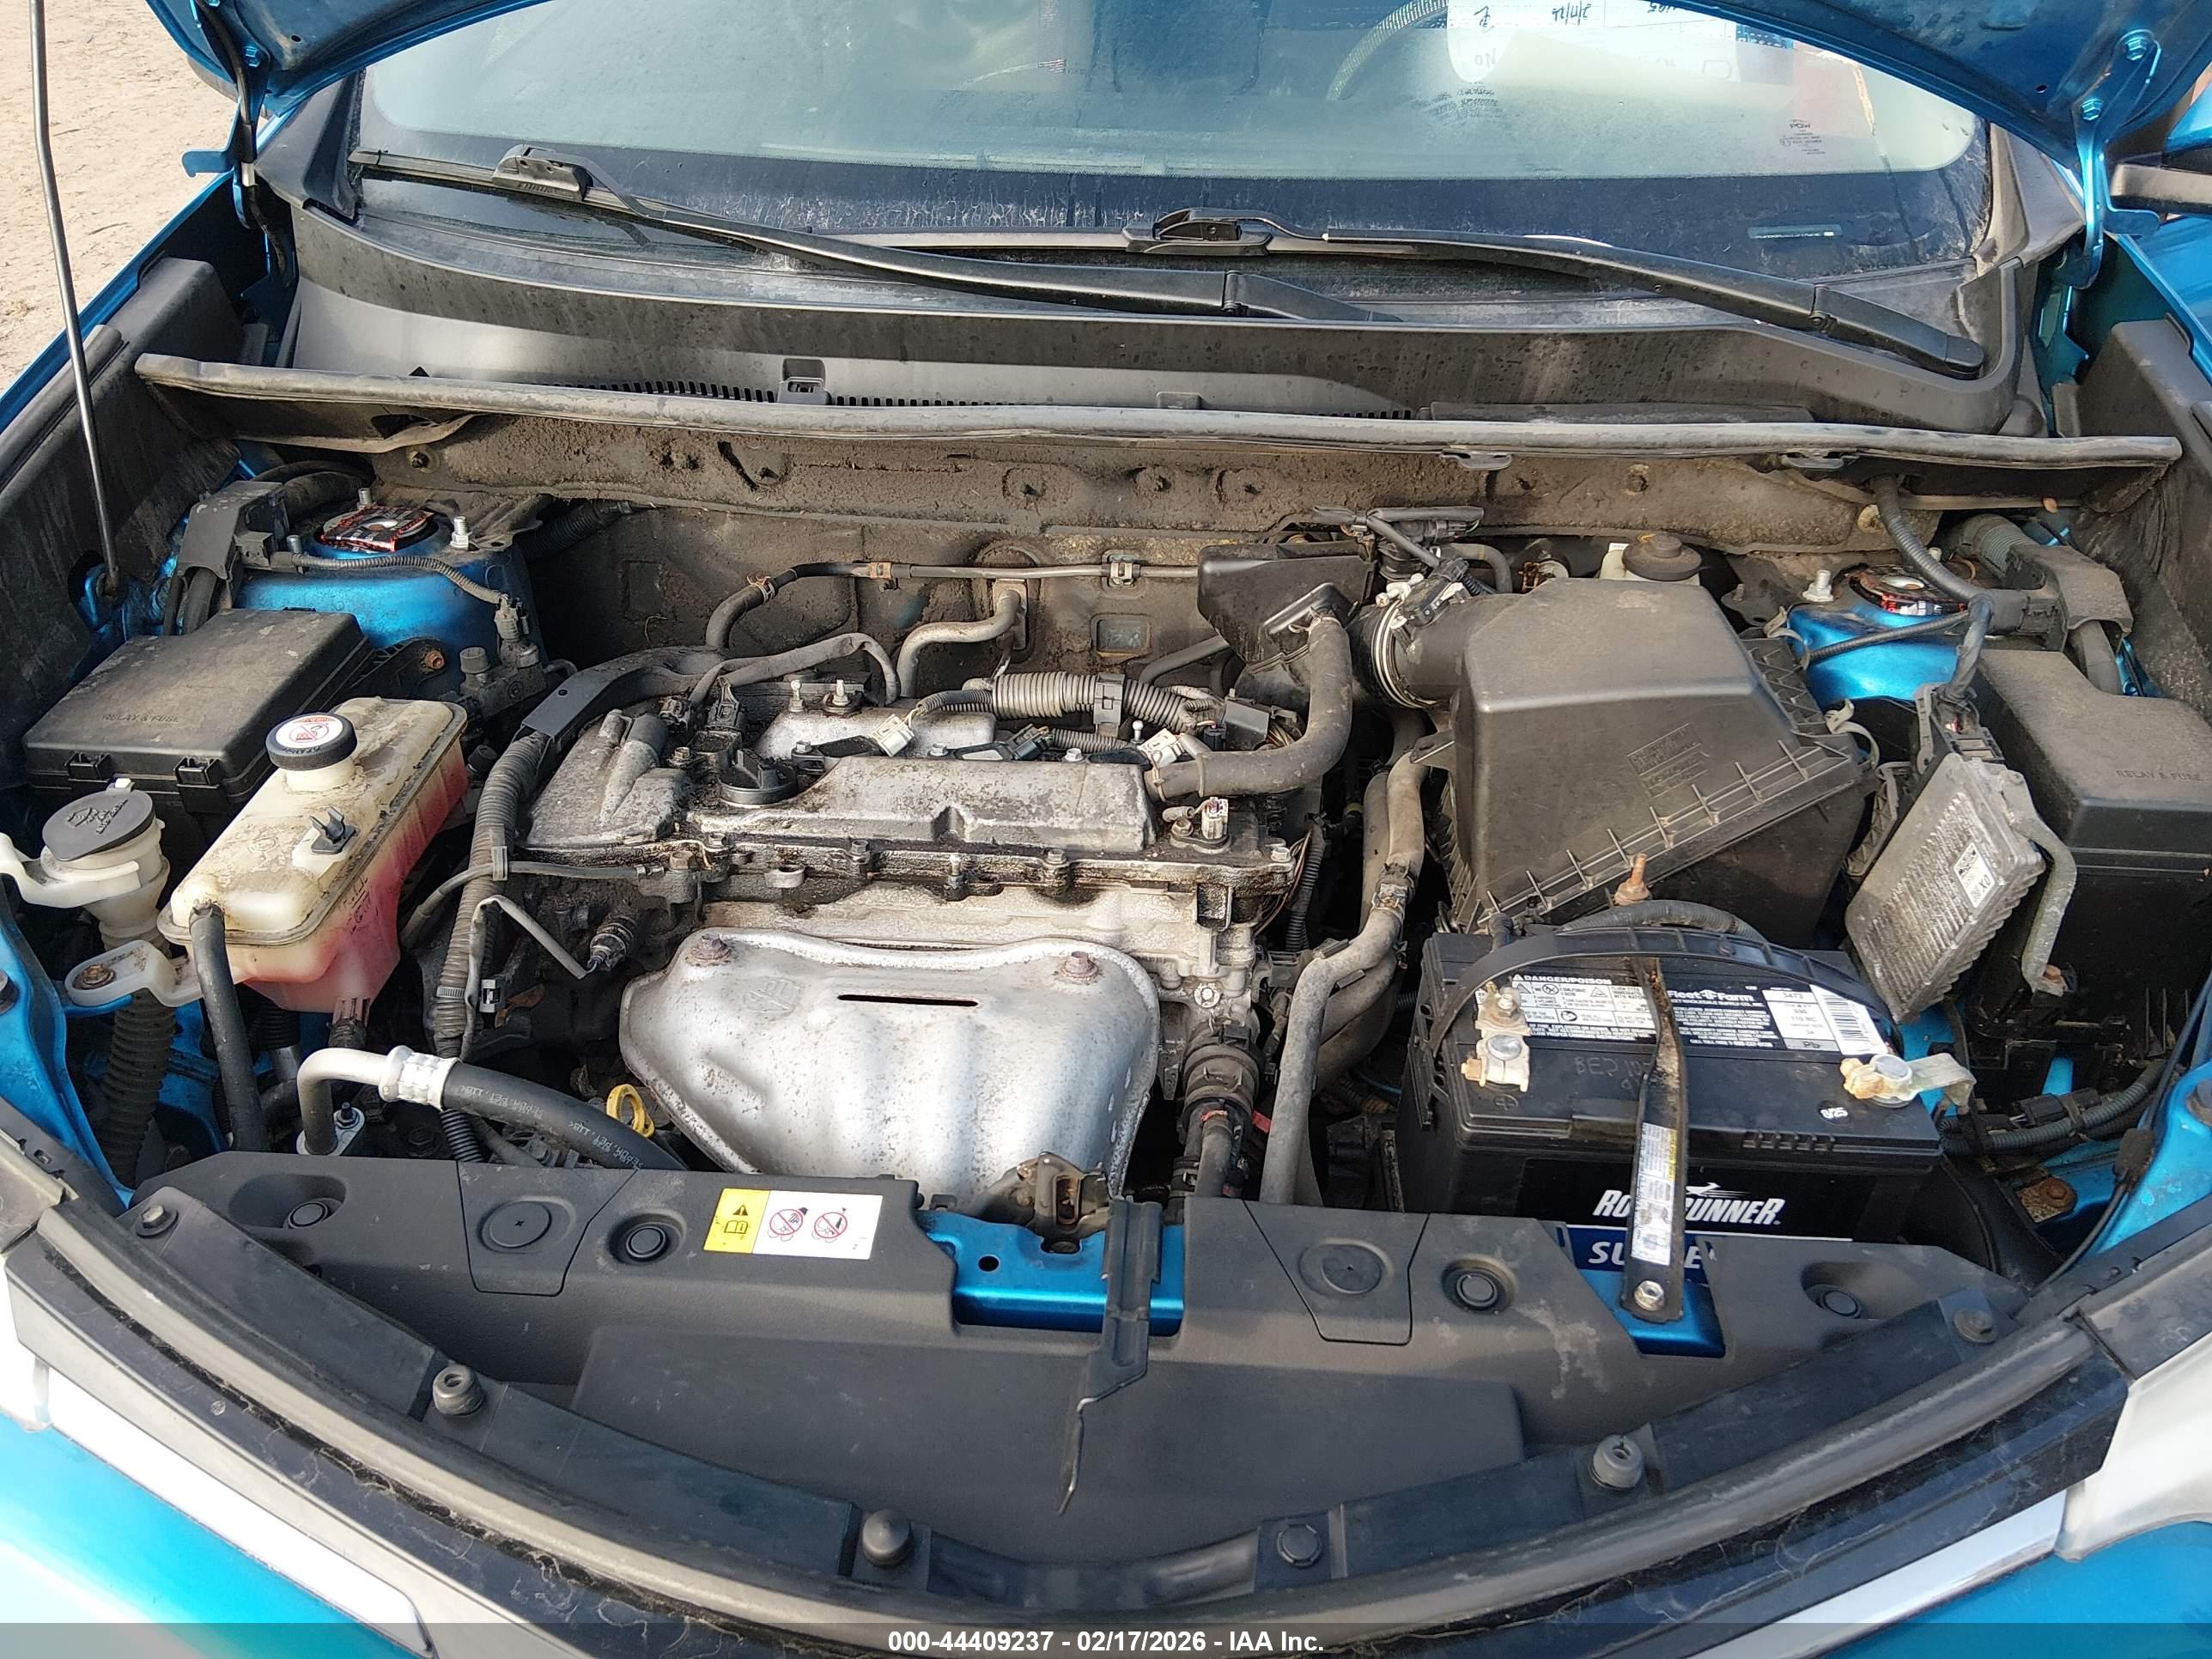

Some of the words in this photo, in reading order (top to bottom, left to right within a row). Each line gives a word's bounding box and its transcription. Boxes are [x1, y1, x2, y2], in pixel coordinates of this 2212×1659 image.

[1666, 989, 1702, 1000] Fleet
[1717, 992, 1755, 1002] Farm
[1593, 1190, 1785, 1225] ROUNNER
